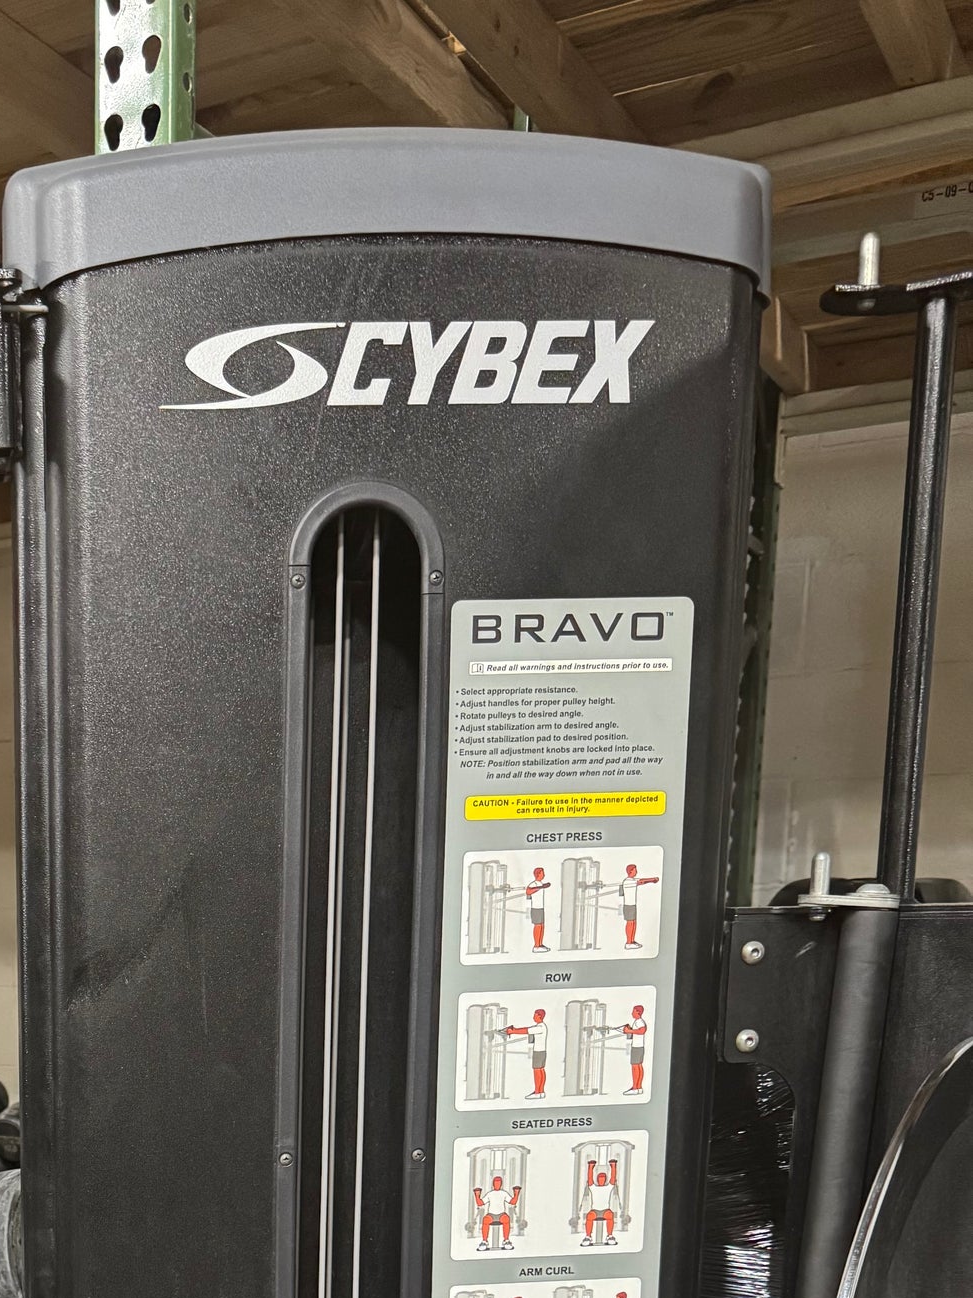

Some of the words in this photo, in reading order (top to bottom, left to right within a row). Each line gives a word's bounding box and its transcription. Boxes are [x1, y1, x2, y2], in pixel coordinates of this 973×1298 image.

[326, 320, 656, 406] CYBEX
[486, 664, 507, 672] Read
[520, 663, 555, 673] warnings
[574, 662, 620, 670] instructions
[622, 662, 641, 671] prior
[487, 687, 533, 696] appropriate
[534, 686, 578, 694] resistance.
[460, 700, 486, 709] Adjust
[488, 699, 519, 707] handles
[534, 699, 561, 707] proper
[562, 698, 587, 707] pulley
[588, 697, 616, 706] height.
[460, 712, 486, 720] Rotate
[487, 711, 516, 721] pulleys
[528, 710, 558, 718] desired
[559, 710, 584, 719] angle.
[459, 725, 486, 733] Adjust
[487, 723, 535, 731] stabilization
[595, 721, 619, 730] angle.
[459, 736, 485, 745] Adjust
[486, 735, 535, 743] stabilization
[536, 735, 551, 743] pad
[594, 733, 629, 743] position.
[516, 798, 543, 806] Failure
[625, 795, 659, 804] depicted
[526, 833, 563, 843] CHEST
[565, 832, 603, 842] PRESS
[545, 973, 572, 983] ROW
[511, 1119, 554, 1129] SEATED
[556, 1117, 593, 1128] PRESS
[519, 1267, 542, 1277] ARM
[545, 1266, 574, 1276] CURL
